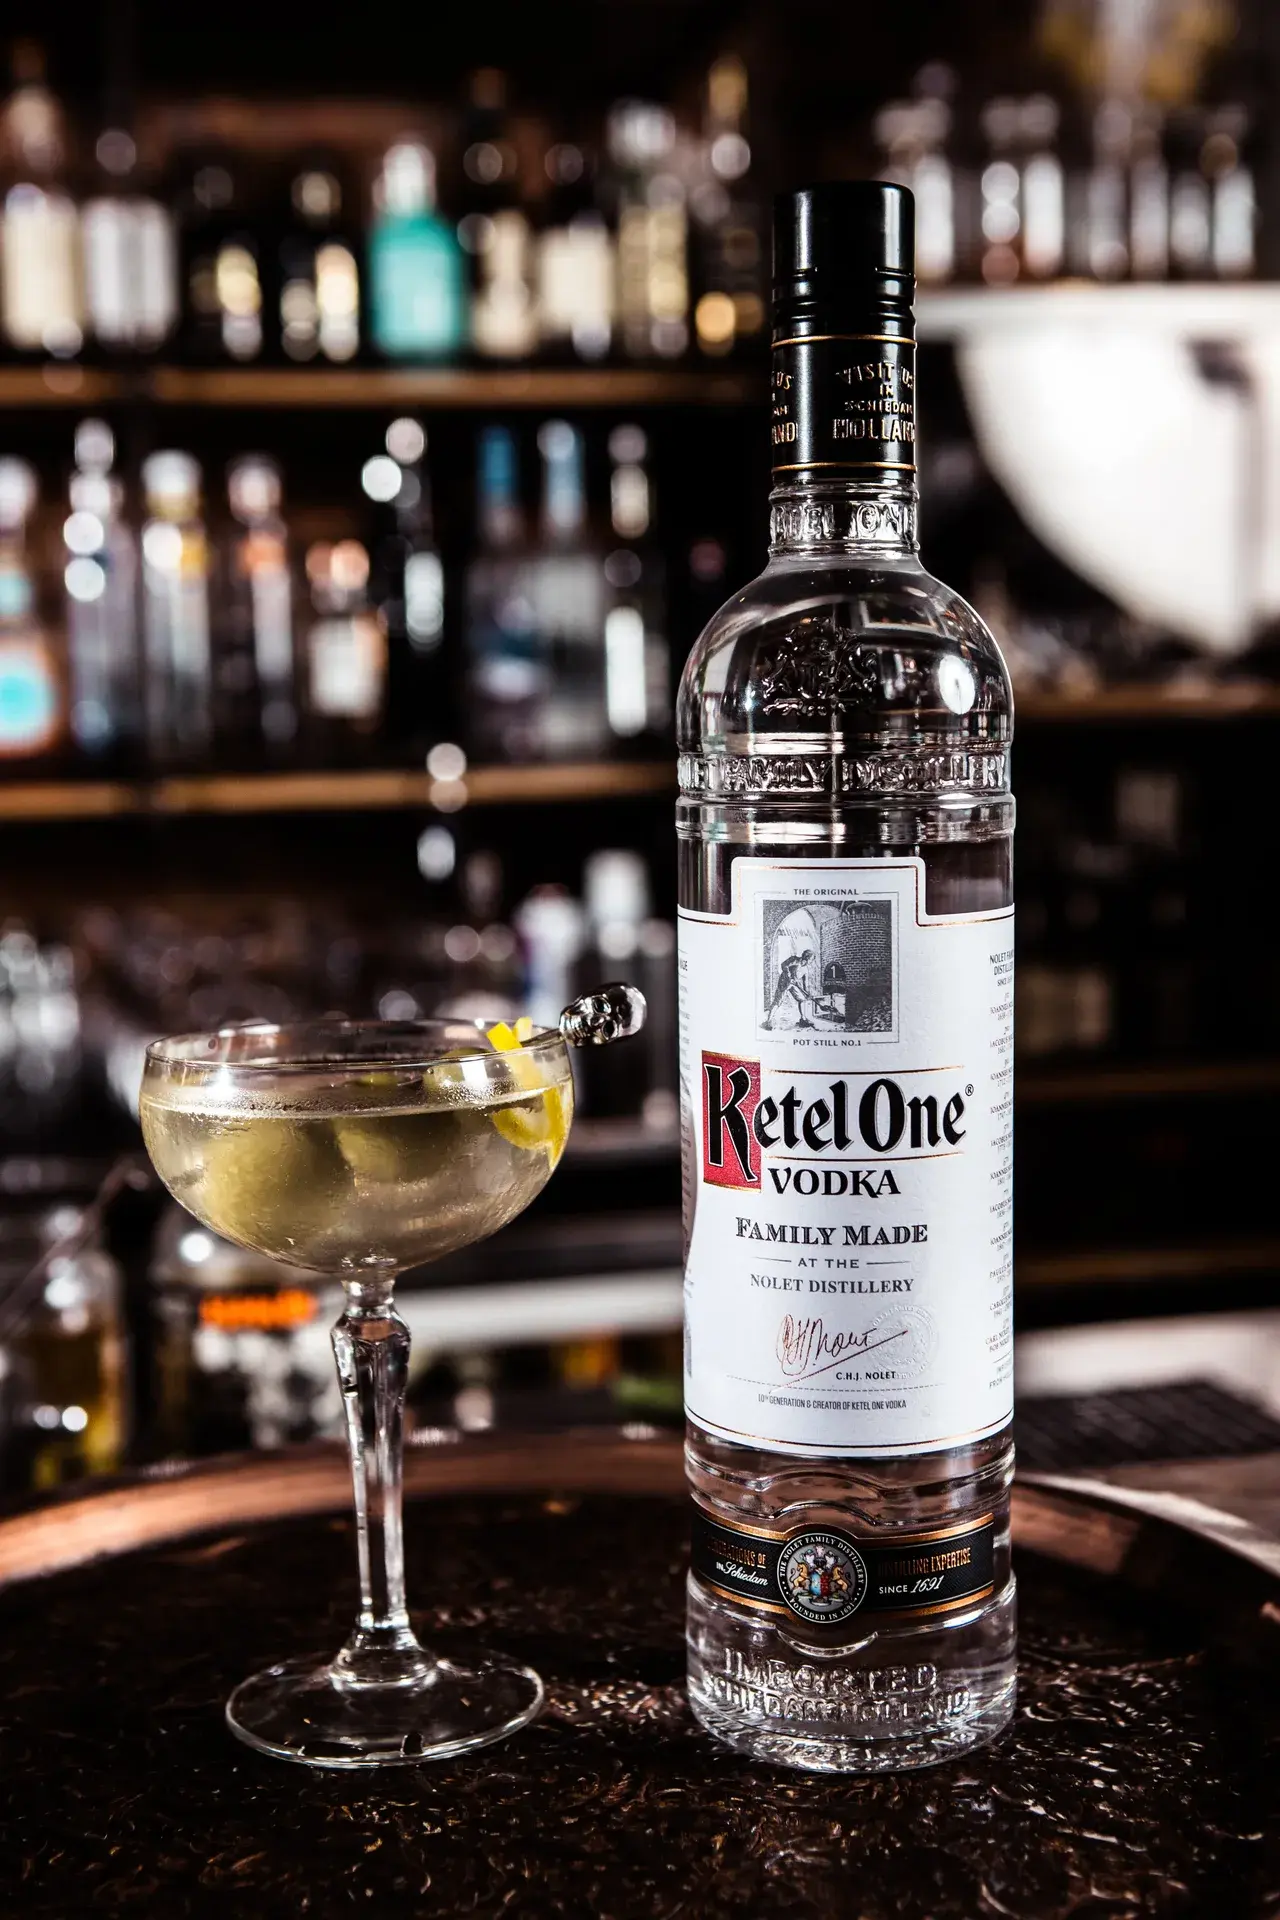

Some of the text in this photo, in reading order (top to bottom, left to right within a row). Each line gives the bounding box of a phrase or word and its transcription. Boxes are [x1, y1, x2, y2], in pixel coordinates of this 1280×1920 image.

[879, 383, 894, 398] IN
[793, 888, 859, 896] THE ORIGINAL
[830, 965, 836, 979] 1
[793, 1039, 862, 1047] POT STILL NO.1
[703, 1063, 853, 1183] Ketel
[768, 1168, 901, 1199] VODKA
[735, 1217, 928, 1246] FAMILY MADE
[797, 1258, 860, 1269] AT THE
[750, 1274, 914, 1293] NOLET DISTILLERY
[836, 1371, 896, 1381] C.H.J. NOLET
[769, 1395, 805, 1408] GENERATION
[806, 1400, 811, 1408] &
[812, 1400, 841, 1410] CREATOR
[842, 1401, 850, 1410] OF
[852, 1401, 871, 1410] KETEL
[872, 1400, 884, 1410] ONE
[885, 1399, 907, 1409] VODKA
[758, 1553, 766, 1567] OF
[783, 1540, 803, 1559] NOLET
[805, 1536, 836, 1545] FAMILY
[837, 1542, 864, 1584] DISTILLERY
[931, 1547, 971, 1572] EXPERTISE
[716, 1561, 768, 1586] IN Schiedam
[879, 1575, 945, 1594] SINCE 1691
[789, 1598, 826, 1620] FOUNDED
